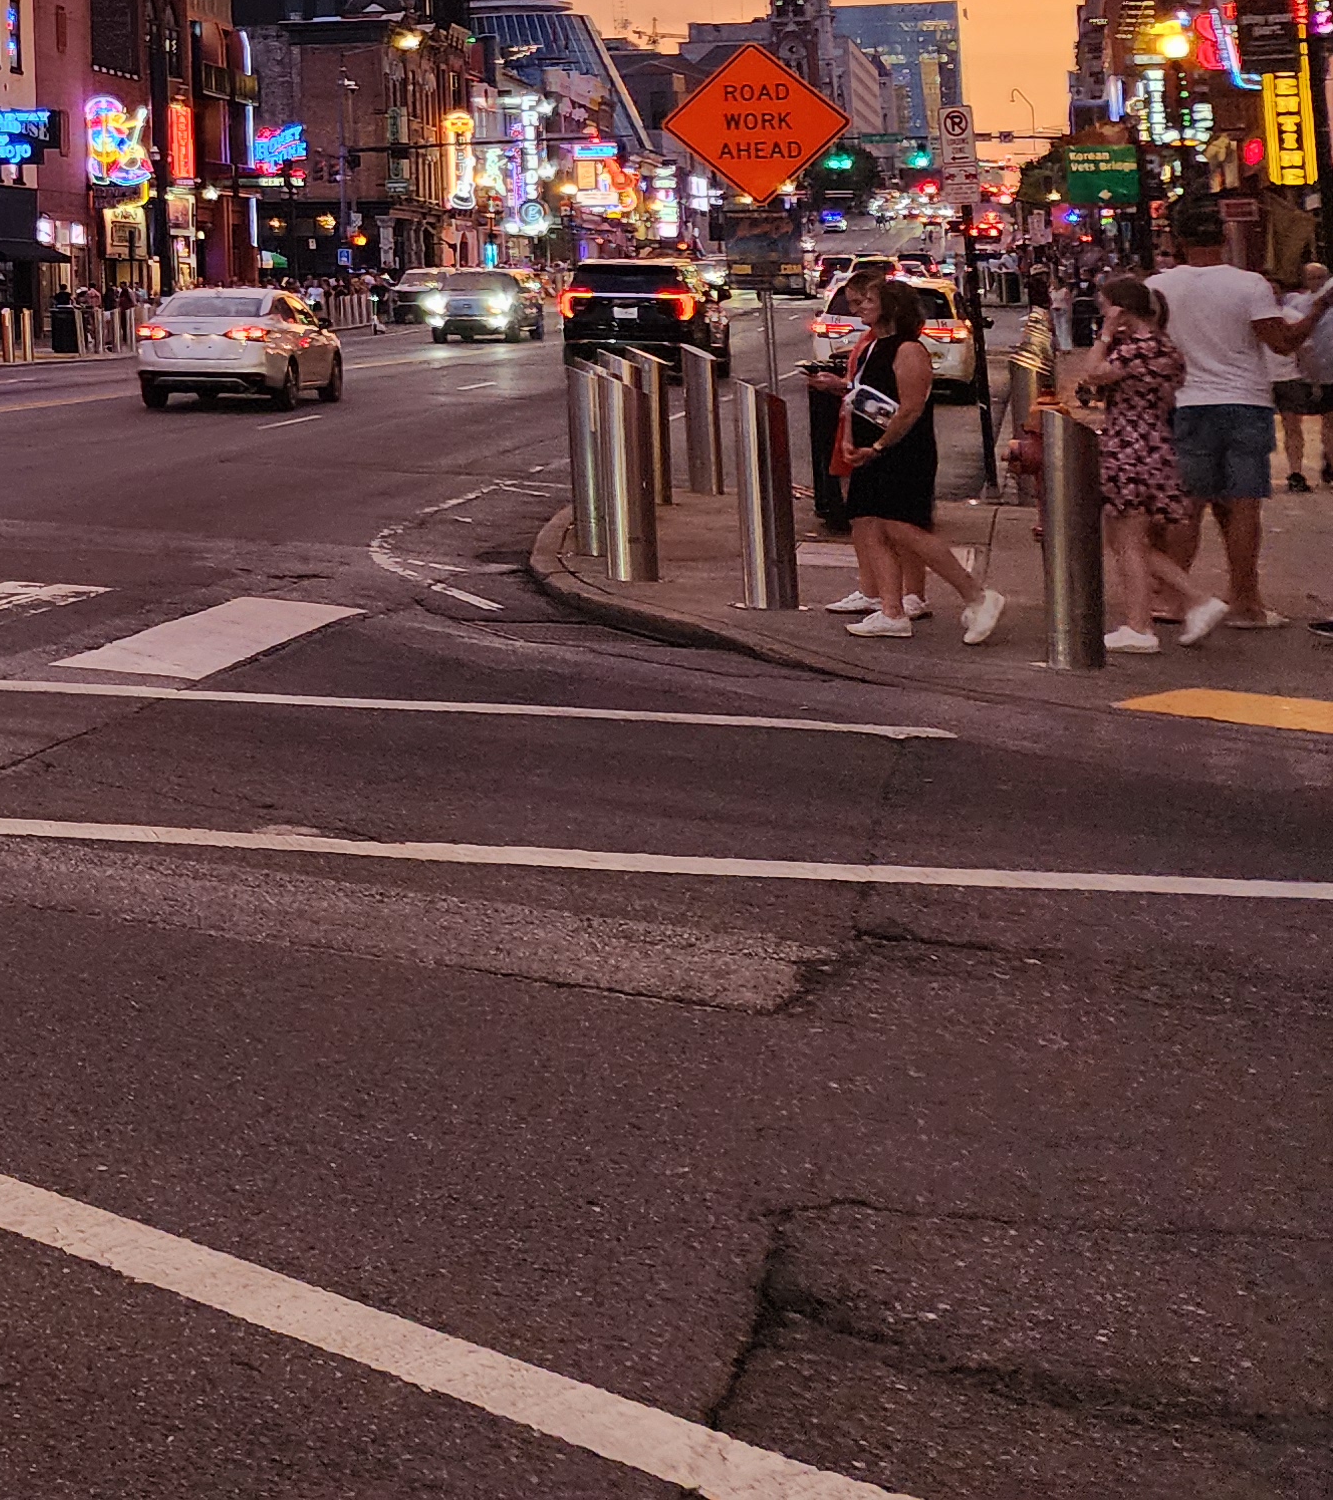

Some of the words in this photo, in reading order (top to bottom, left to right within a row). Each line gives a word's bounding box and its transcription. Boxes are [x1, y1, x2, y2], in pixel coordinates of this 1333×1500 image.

[723, 83, 790, 101] ROAD
[723, 111, 793, 131] WORK
[1273, 71, 1307, 186] ENTINE
[718, 140, 803, 159] AHEAD
[1068, 151, 1110, 161] Korean
[1070, 162, 1096, 172] Vets
